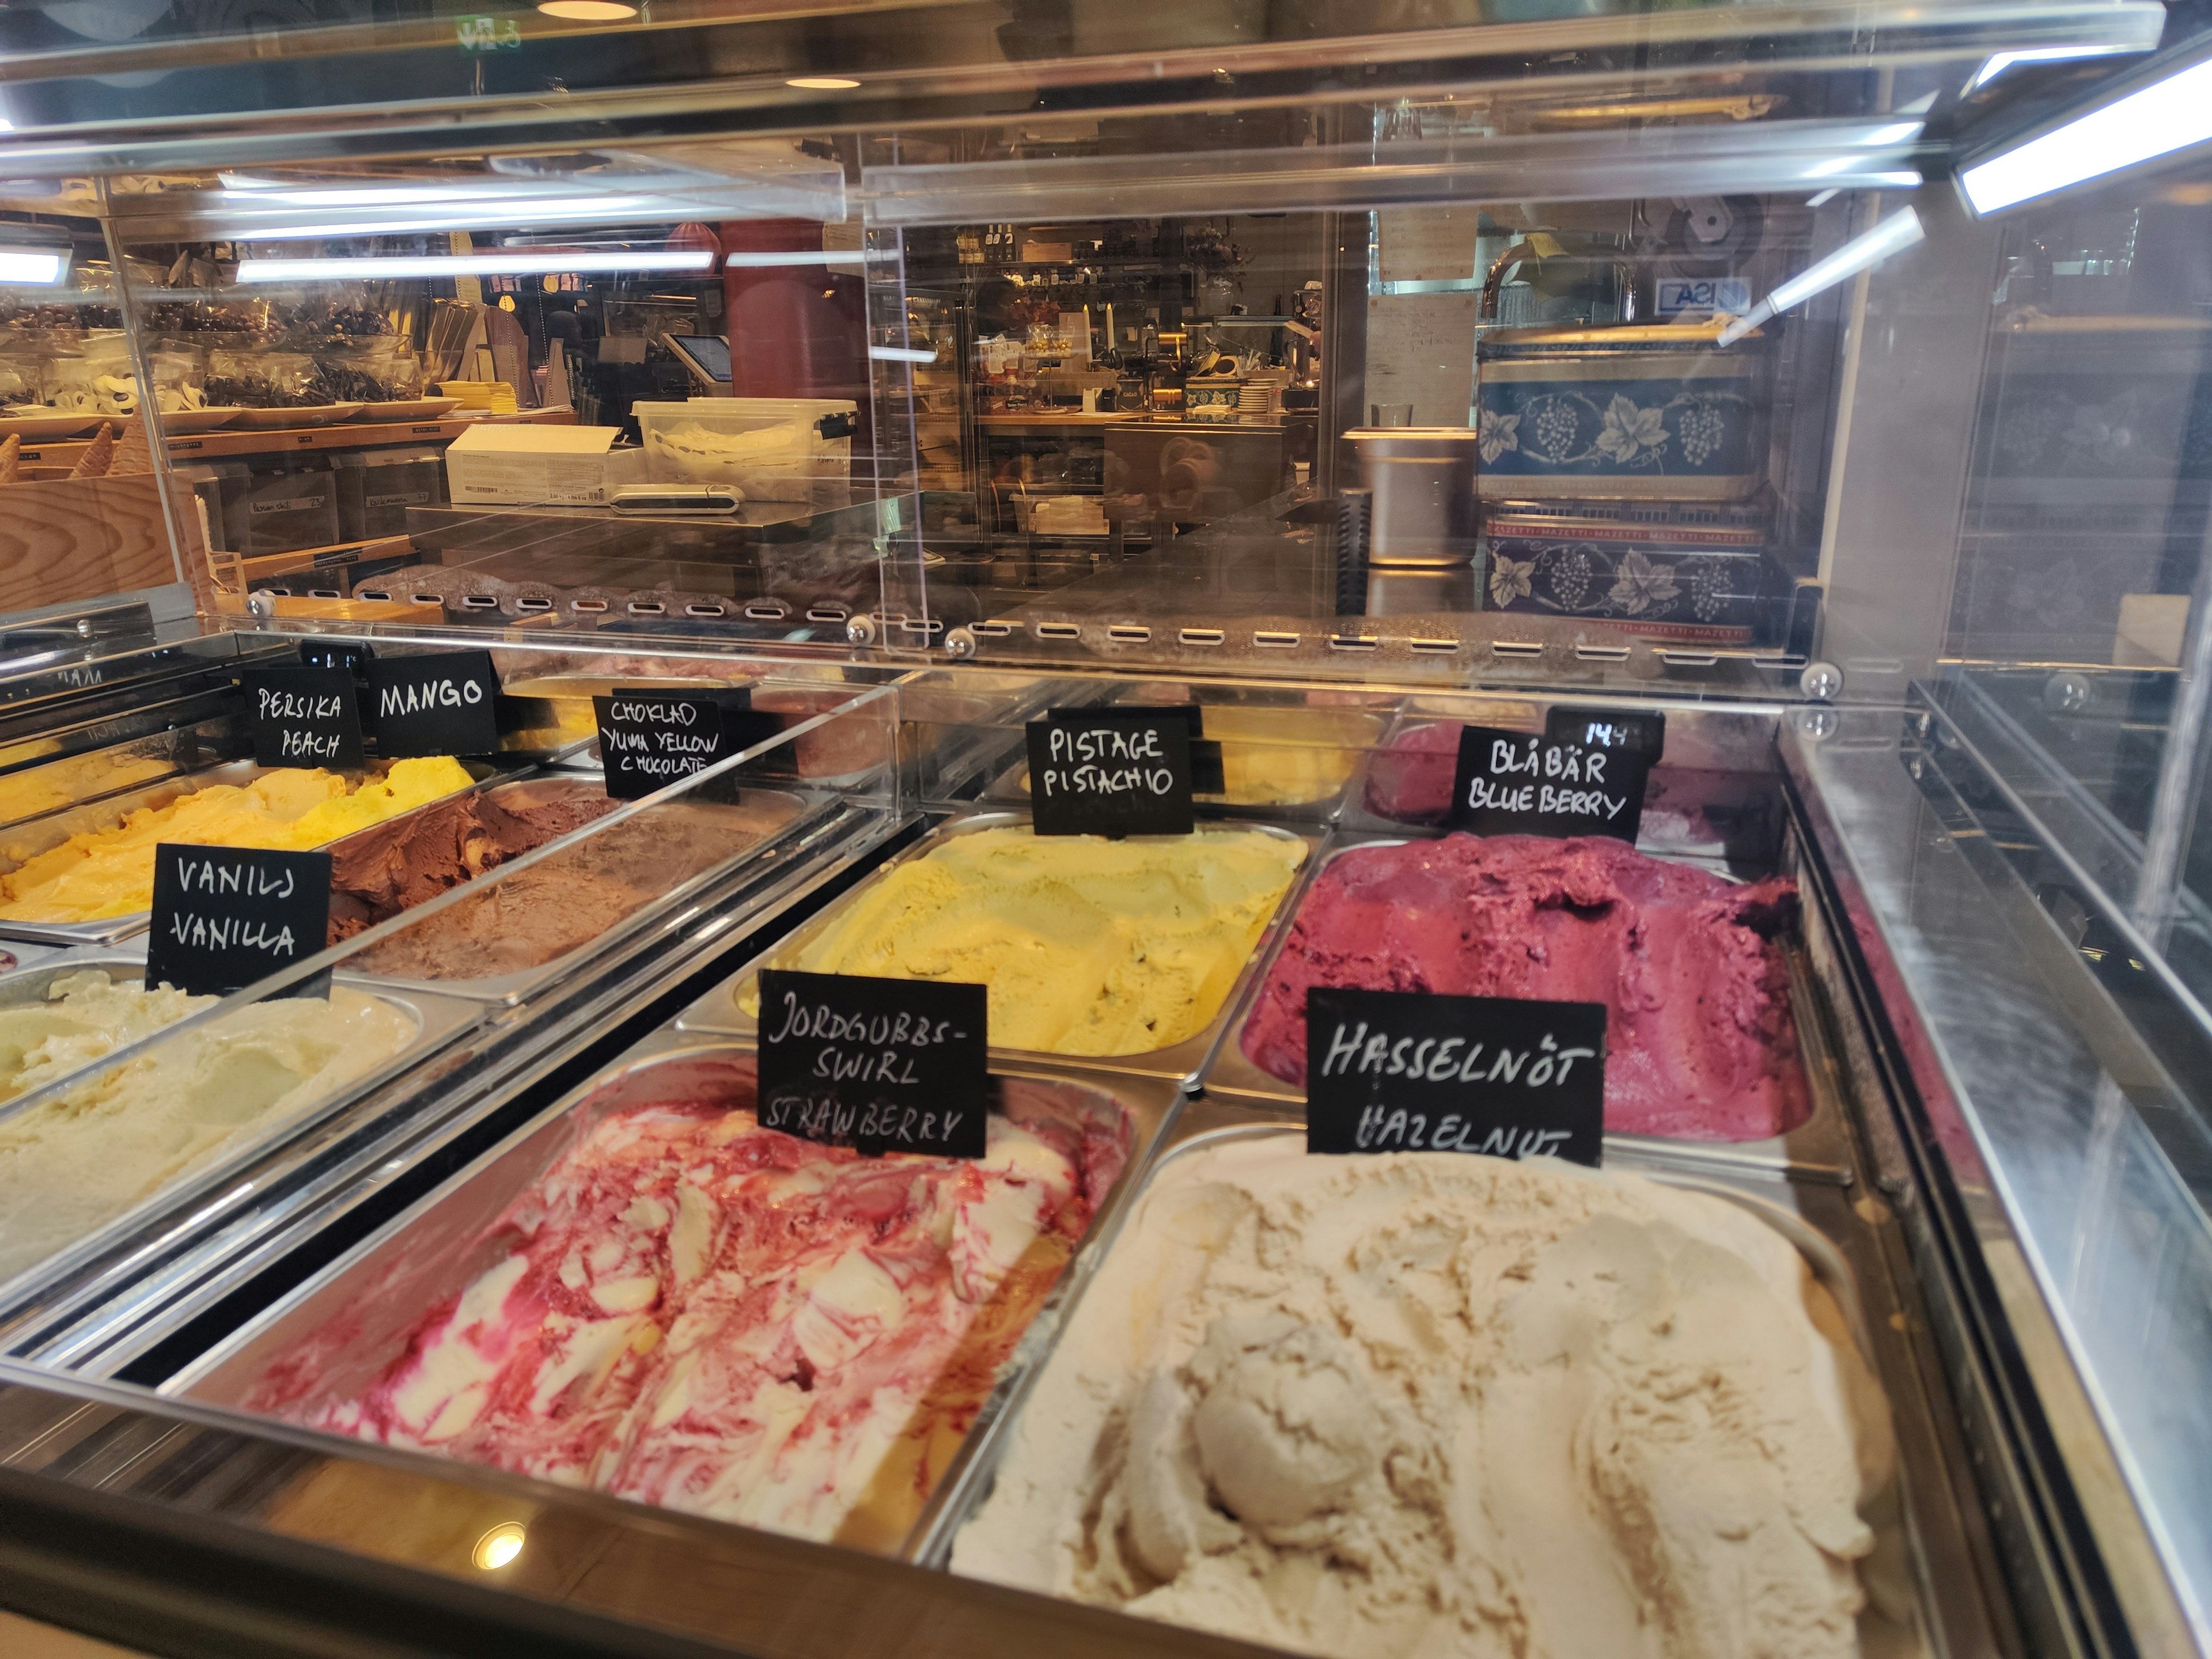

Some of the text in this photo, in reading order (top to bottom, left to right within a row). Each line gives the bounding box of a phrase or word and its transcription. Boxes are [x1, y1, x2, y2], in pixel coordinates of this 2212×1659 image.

[1541, 528, 1588, 537] MAZETTI
[1594, 529, 1641, 540] MAZETTI
[1650, 531, 1698, 541] MAZETTI
[1640, 625, 1688, 635] MAZETTI
[258, 688, 342, 719] PERSIKA
[380, 679, 483, 718] MANGO
[611, 702, 697, 726] CHOKLAD
[282, 729, 340, 757] PEACH
[654, 732, 719, 753] YELLOW
[1050, 728, 1164, 763] PISTAGE
[1490, 737, 1607, 784] BLÅBÄR
[1043, 764, 1173, 797] PISTACHIO
[177, 857, 294, 899] VANILJ
[171, 911, 296, 956] VANILLA
[768, 990, 968, 1047] JORDGUBBS-
[812, 1046, 920, 1084] SWIRL
[1321, 1021, 1596, 1088] HASSELNÖT
[766, 1096, 964, 1143] STRAWBERRY
[1354, 1104, 1573, 1158] HAZELNUT
